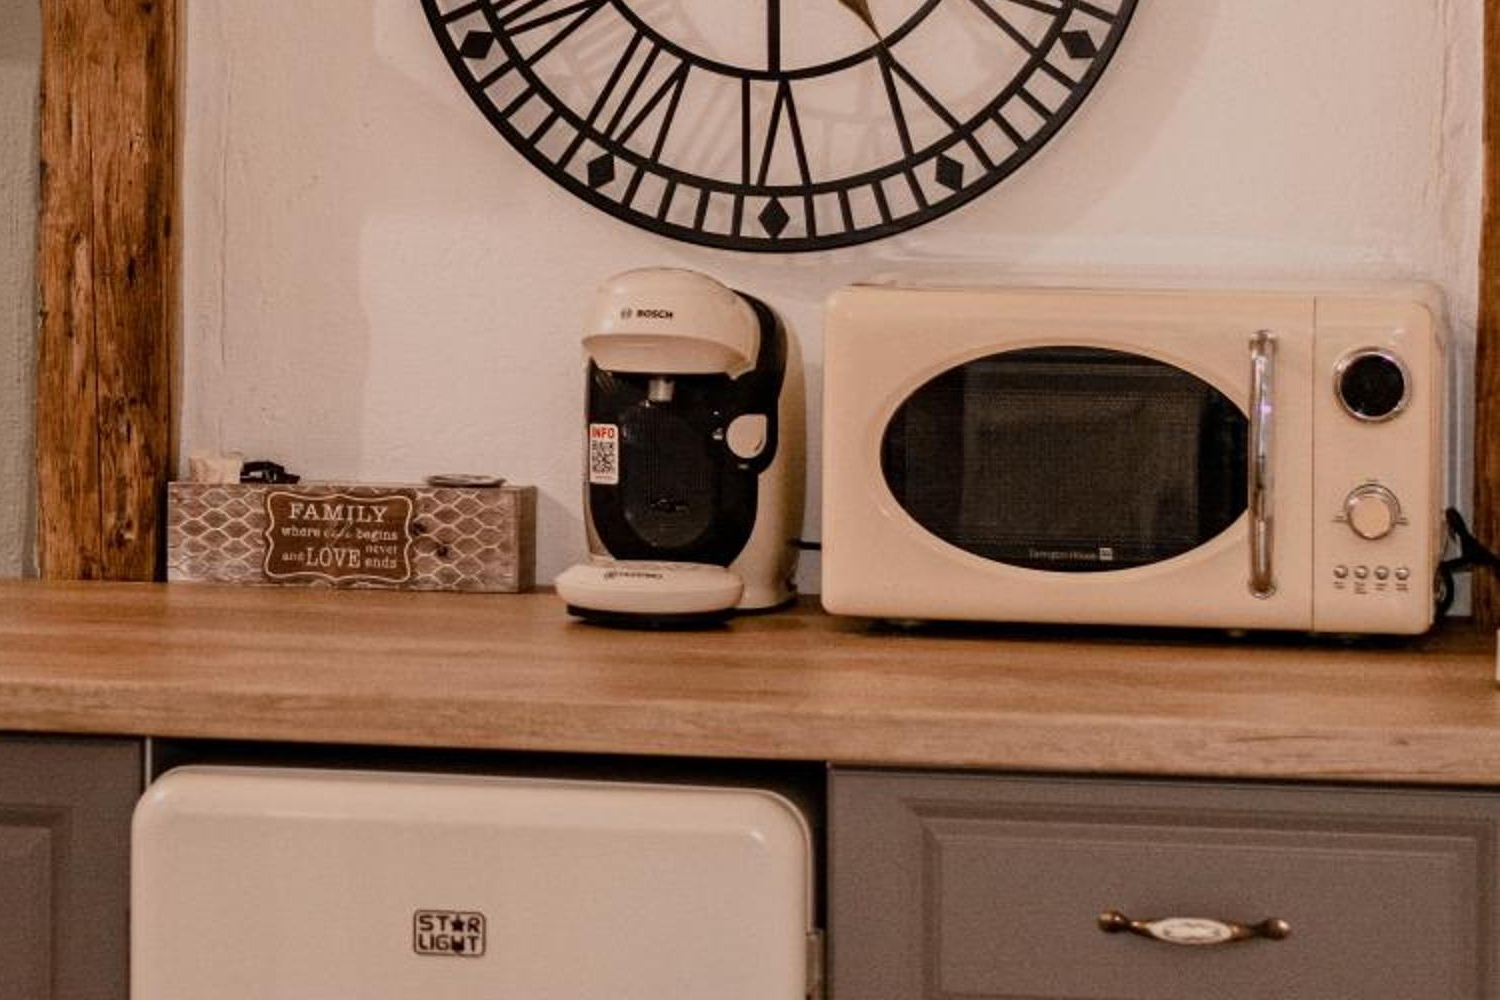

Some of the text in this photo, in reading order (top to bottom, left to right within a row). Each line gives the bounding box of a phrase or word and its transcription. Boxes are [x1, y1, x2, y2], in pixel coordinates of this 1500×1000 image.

[585, 34, 690, 164] VII
[879, 51, 961, 159] V
[742, 78, 812, 187] VI
[637, 308, 673, 319] BOSCH
[591, 426, 615, 439] INFO
[288, 502, 389, 523] FAMILY
[281, 525, 321, 537] where
[356, 529, 399, 542] begins
[305, 546, 361, 569] LOVE
[364, 556, 398, 569] ends
